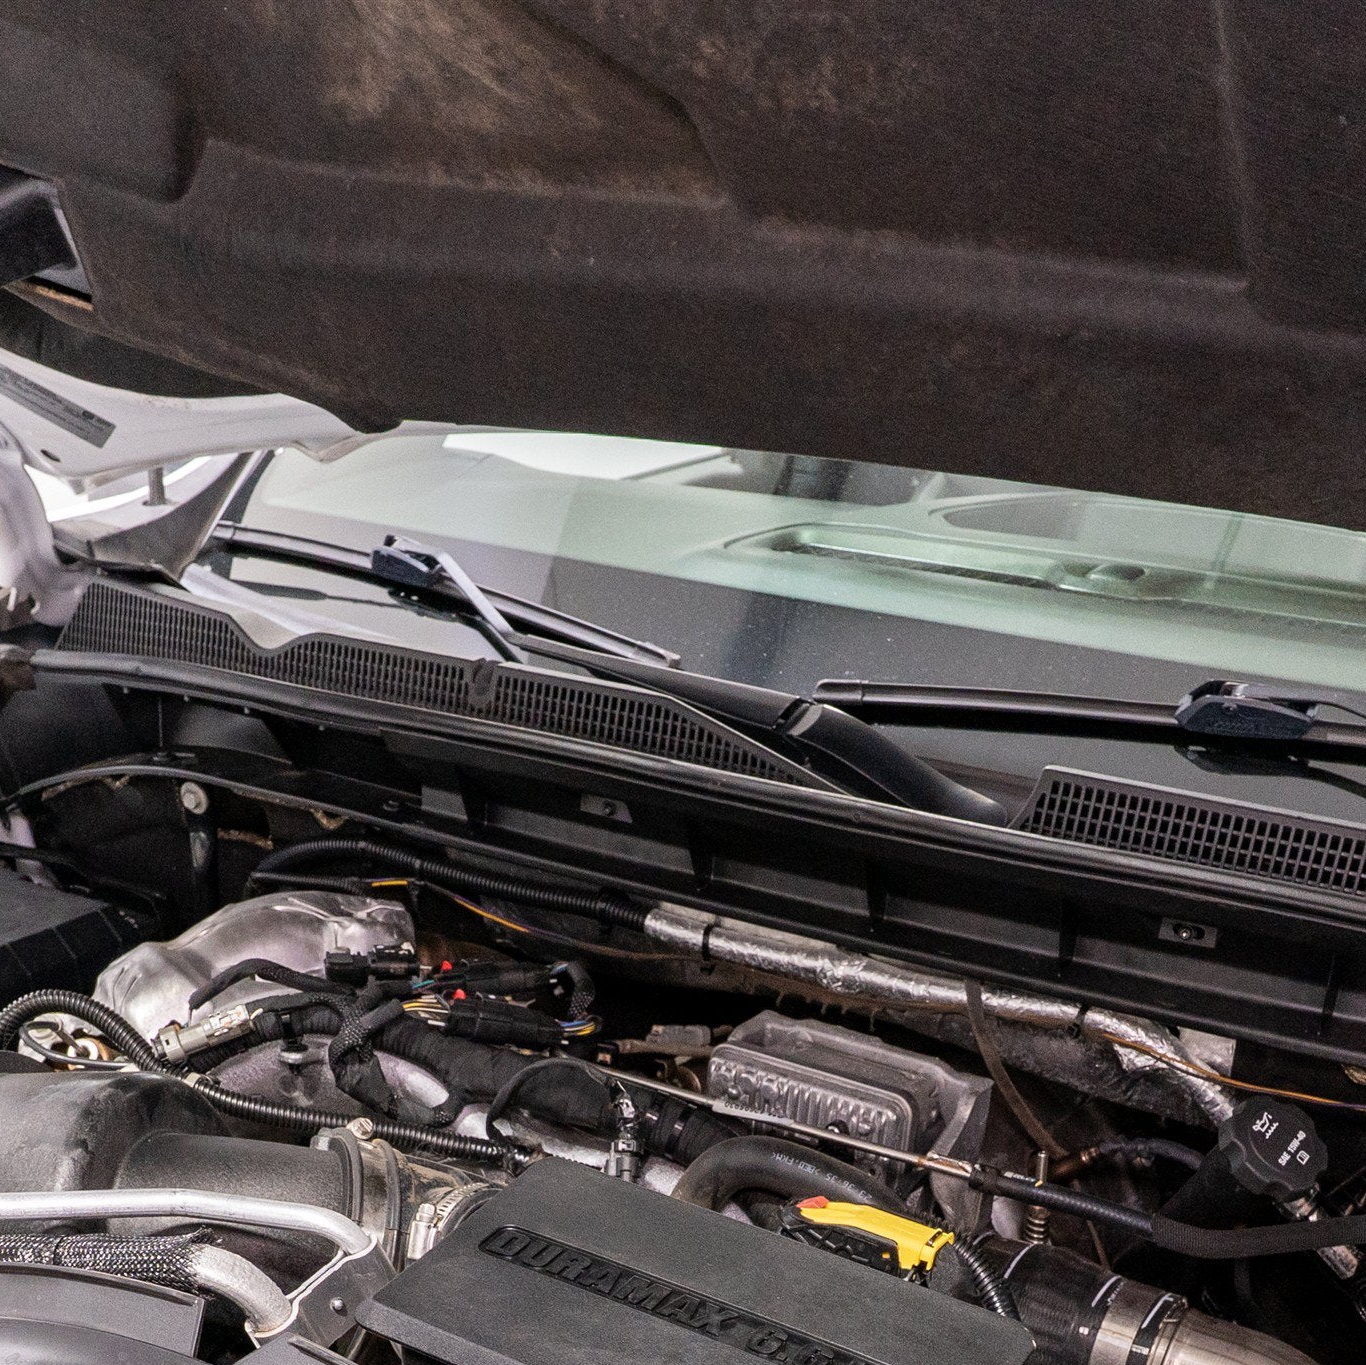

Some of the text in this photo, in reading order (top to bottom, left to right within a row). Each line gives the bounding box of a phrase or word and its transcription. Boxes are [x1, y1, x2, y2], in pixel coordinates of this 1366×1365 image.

[1278, 1130, 1306, 1166] SAE 15W-40
[494, 1228, 738, 1338] DURAMAX
